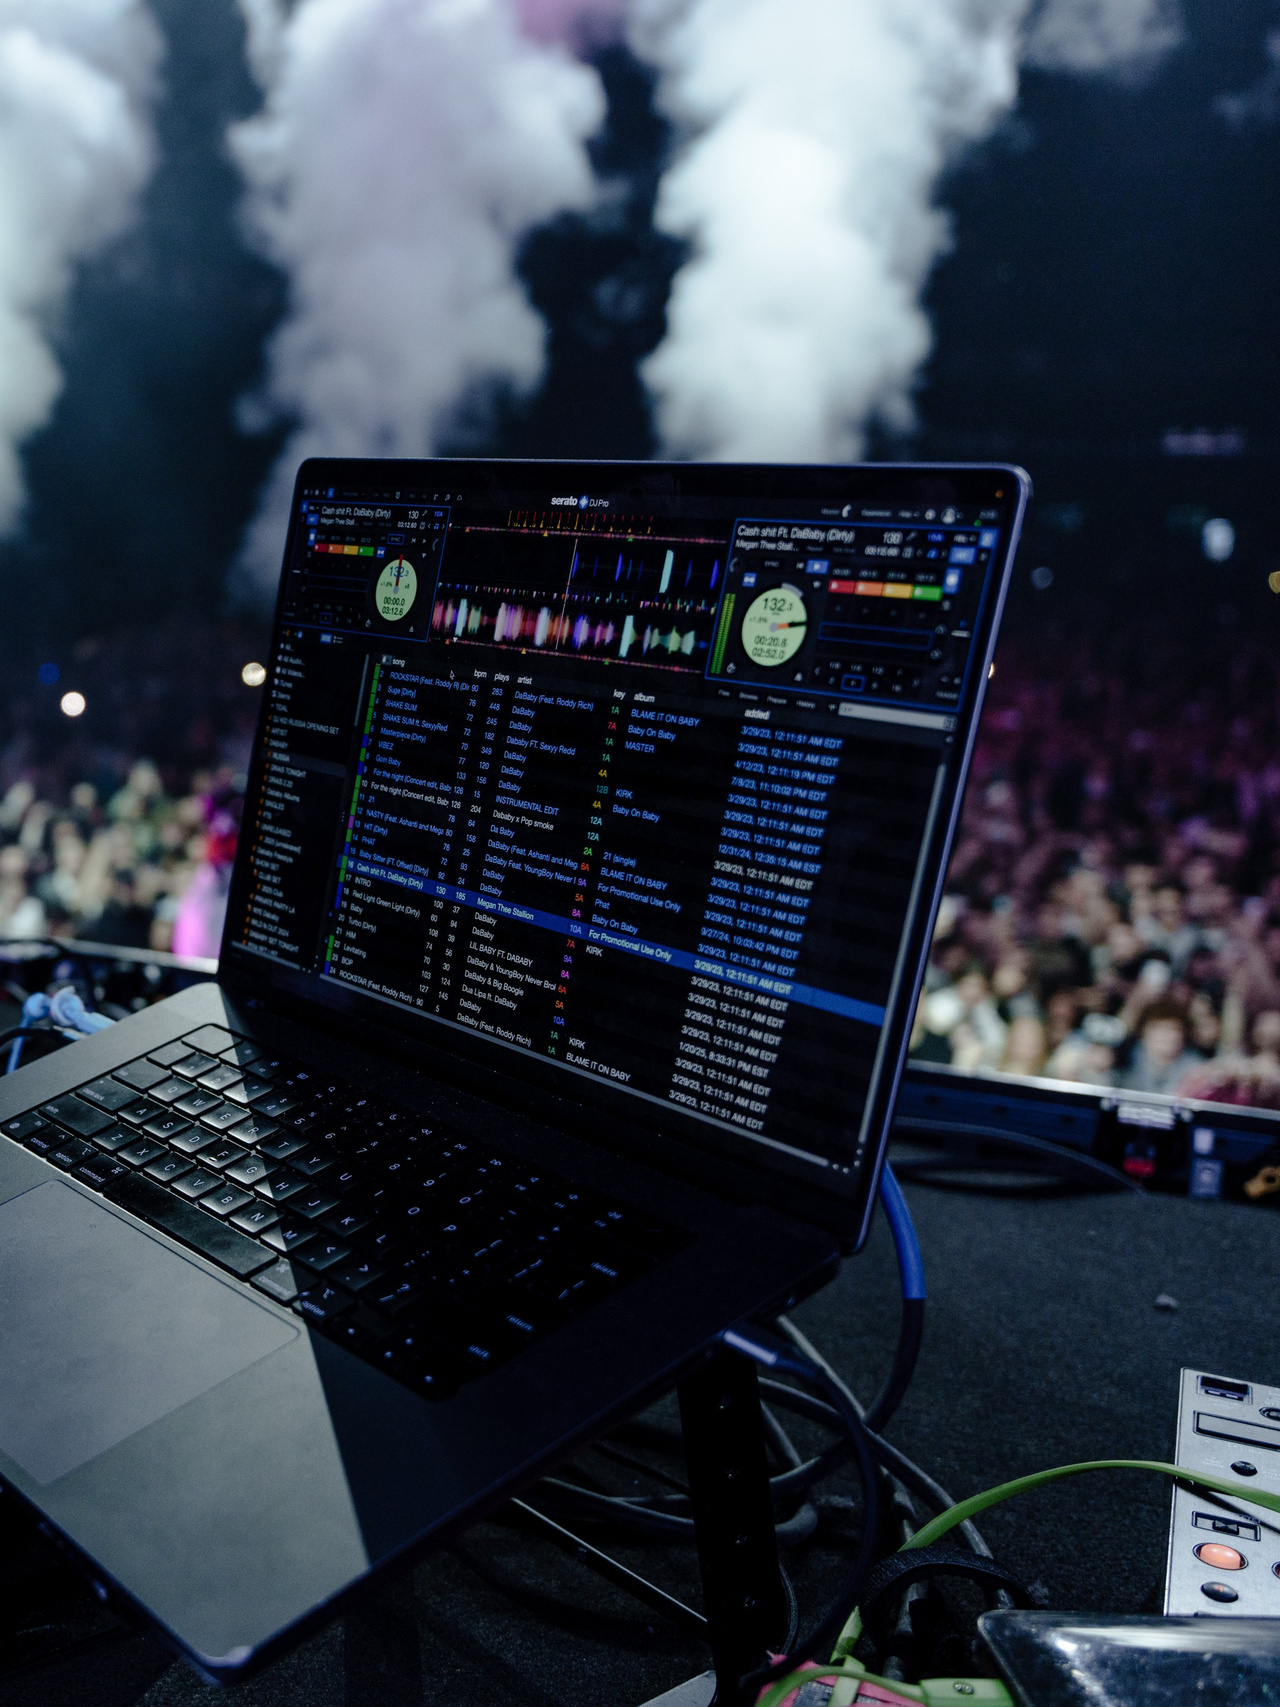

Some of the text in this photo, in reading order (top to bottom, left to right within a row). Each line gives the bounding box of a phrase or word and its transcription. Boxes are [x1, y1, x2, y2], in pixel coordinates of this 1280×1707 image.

[551, 496, 578, 505] serato
[321, 506, 335, 514] Cash
[353, 507, 375, 518] DaBaby
[375, 508, 391, 519] (Dirty)
[408, 510, 419, 519] 130
[320, 517, 334, 525] Megan
[737, 525, 854, 543] Cash shit Ft. DaBaby (Dirty)
[735, 539, 759, 550] Megan
[760, 540, 776, 549] Thee
[383, 596, 405, 606] 00:00.0
[380, 606, 404, 616] 03:12.6
[392, 658, 405, 667] song
[473, 669, 487, 678] bpm
[494, 672, 509, 682] plays
[389, 671, 419, 682] ROCKSTAR
[434, 678, 453, 689] Roddy
[517, 676, 532, 684] artist
[471, 684, 479, 692] 90
[491, 687, 503, 696] 283
[613, 689, 626, 700] key
[633, 692, 655, 702] album
[514, 690, 538, 703] DaBaby
[556, 697, 577, 709] Roddy
[577, 700, 594, 711] Rich)
[611, 706, 619, 714] 1A
[744, 709, 770, 719] added
[382, 713, 401, 723] SHAKE
[401, 716, 415, 725] SUM
[630, 708, 700, 726] BLAME IT ON BABY
[328, 726, 339, 734] SET
[463, 727, 471, 736] 72
[627, 724, 676, 742] Baby On Baby
[484, 732, 495, 740] 182
[506, 735, 529, 748] Dababy
[539, 741, 558, 753] Sexyy
[558, 745, 576, 755] Redd
[807, 736, 823, 746] AM
[822, 737, 843, 749] EDT
[370, 781, 379, 789] For
[379, 784, 388, 792] the
[388, 787, 401, 795] night
[401, 789, 424, 800] (Concert
[792, 787, 808, 798] PM
[807, 789, 827, 801] EDT
[495, 795, 559, 815] INSTRUMENTAL EDIT
[492, 809, 515, 823] Dababy
[520, 816, 533, 826] Pop
[533, 820, 554, 830] smoke
[590, 816, 602, 825] 12A
[490, 824, 515, 838] Da Baby
[583, 846, 592, 856] 2A
[603, 851, 636, 868] 21 (single)
[357, 863, 369, 872] Cash
[370, 867, 379, 875] shit
[387, 871, 407, 885] DaBaby
[407, 877, 423, 889] (Dirty)
[436, 885, 446, 894] 130
[455, 891, 466, 900] 185
[477, 897, 534, 920] Megan Thee Stallion
[570, 924, 581, 934] 10A
[343, 943, 366, 958] Levitating
[588, 929, 672, 962] For Promotional Use Only
[478, 943, 496, 955] BABY
[506, 952, 533, 967] DABABY
[441, 977, 450, 986] 124
[464, 969, 486, 984] DaBaby
[492, 978, 502, 990] Big
[503, 982, 524, 996] Boogie
[461, 983, 473, 994] Dua
[473, 988, 486, 999] Lipa
[494, 994, 517, 1010] DaBaby
[553, 1015, 565, 1026] 10A
[736, 1060, 752, 1072] PM
[79, 1166, 106, 1184] command
[301, 1299, 326, 1318] option
